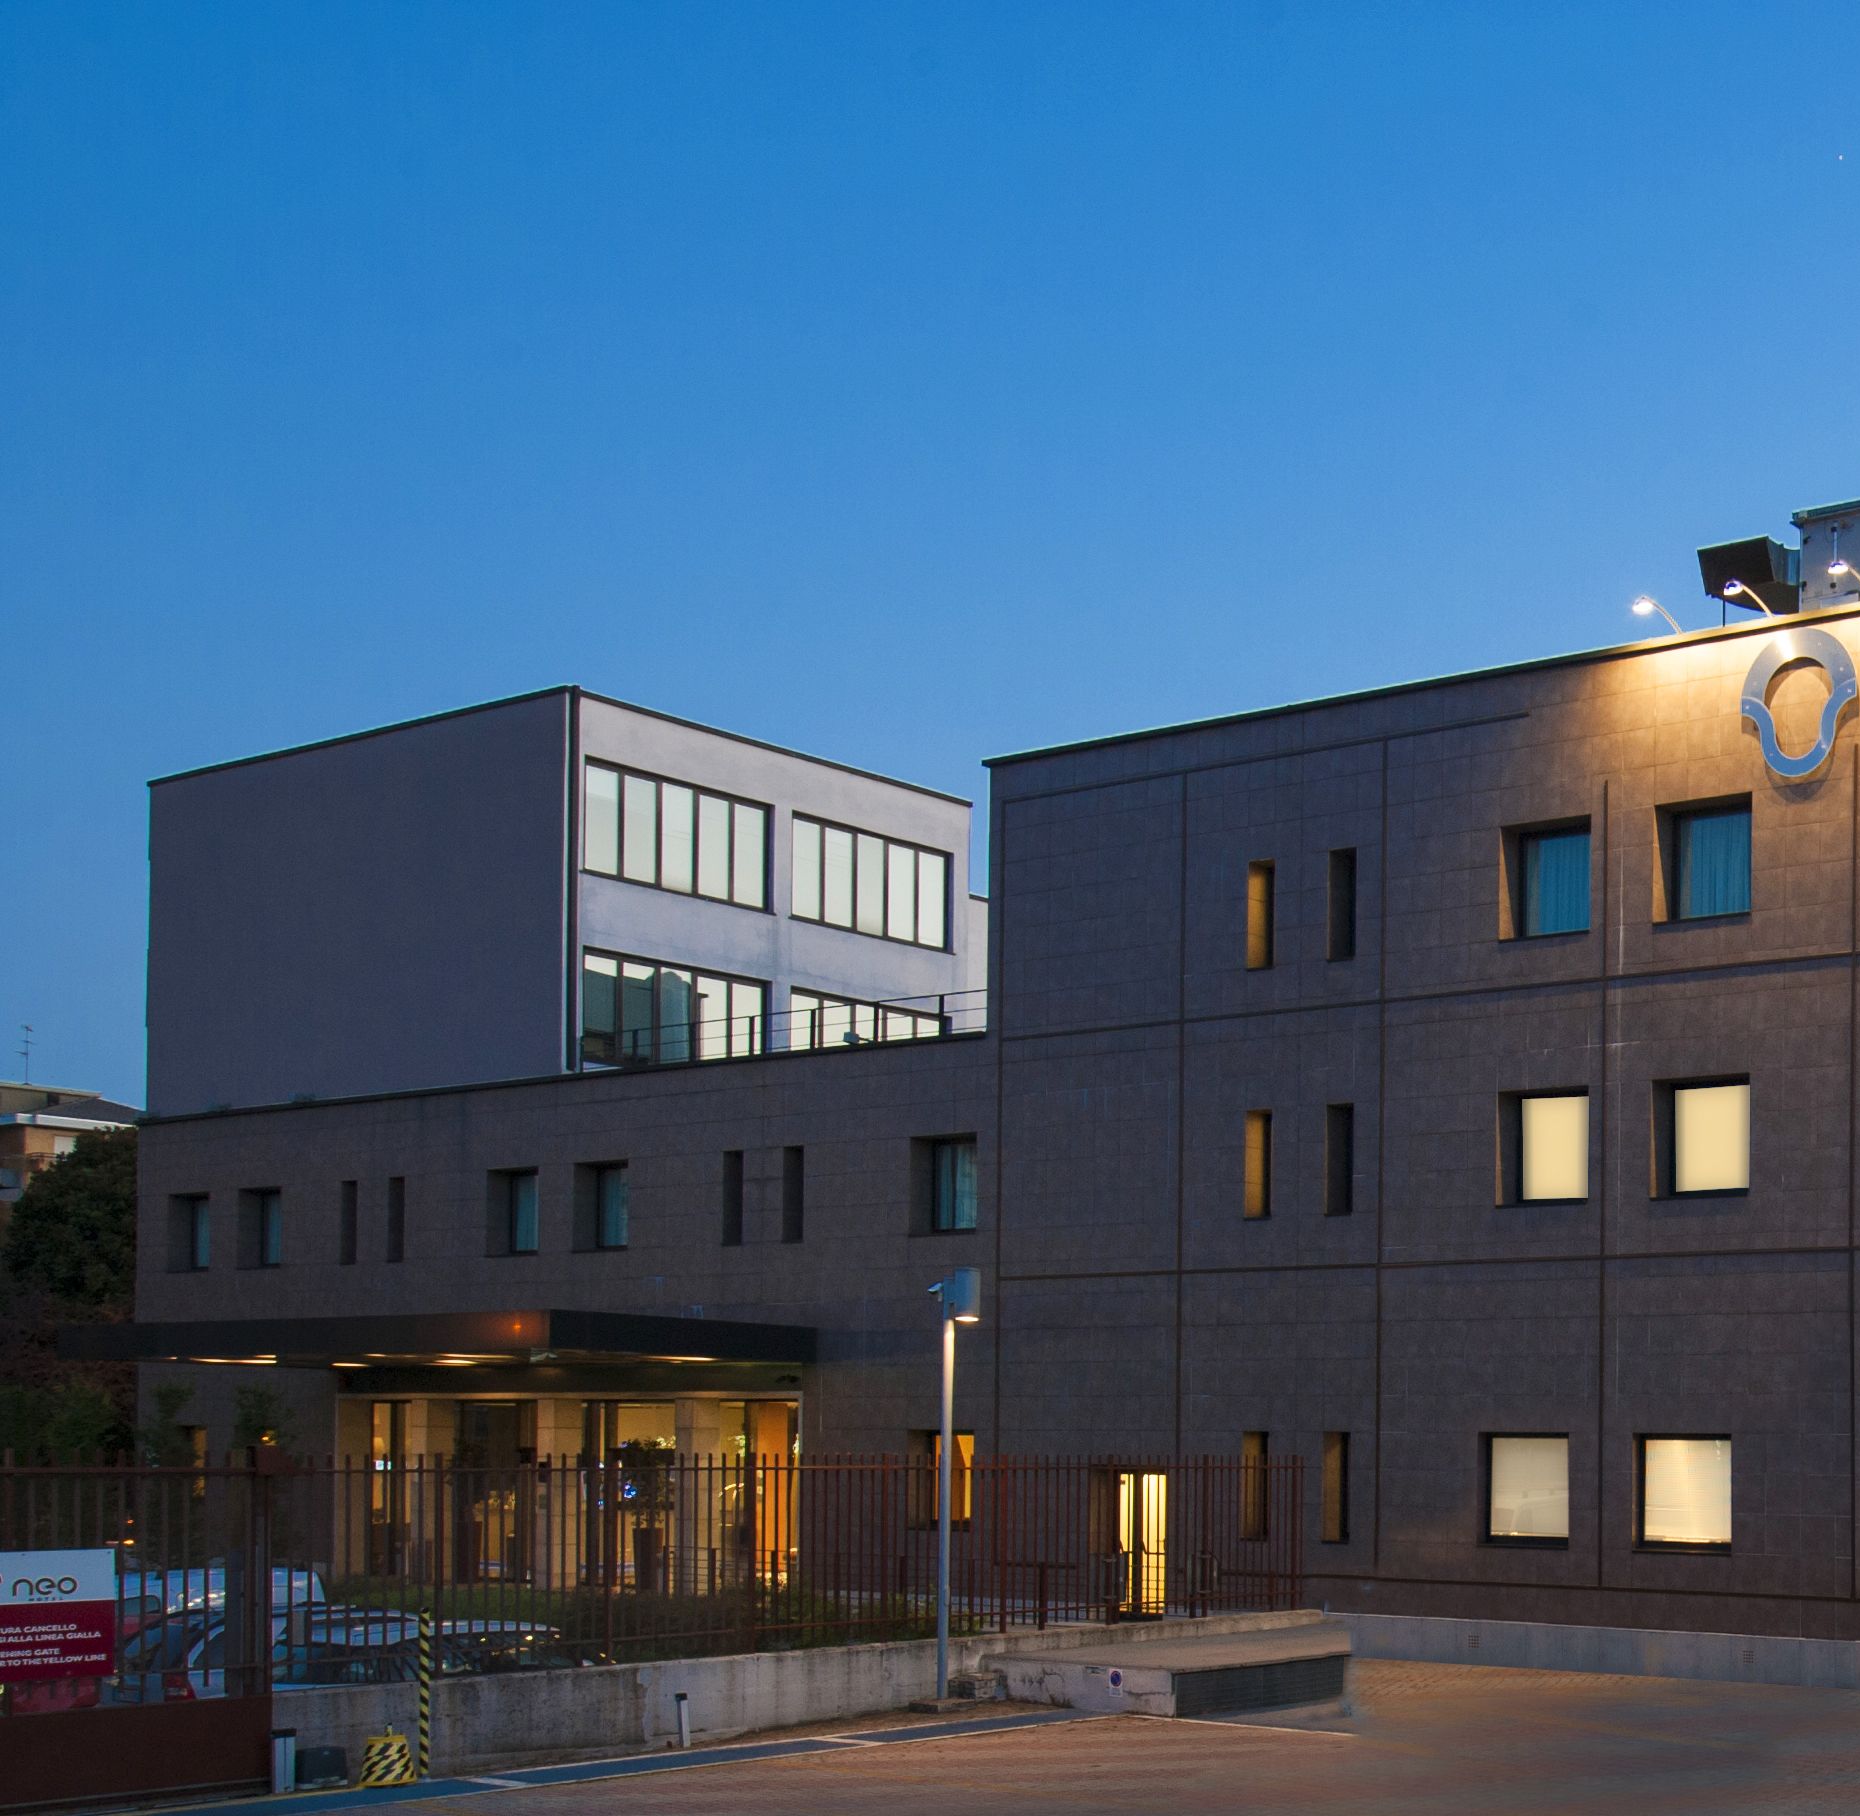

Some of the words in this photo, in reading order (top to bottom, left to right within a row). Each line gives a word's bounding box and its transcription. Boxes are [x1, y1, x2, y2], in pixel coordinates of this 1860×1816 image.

[12, 1577, 78, 1597] neo
[0, 1626, 21, 1634] URA
[24, 1624, 77, 1633] CANCELLO
[8, 1635, 33, 1643] ALLA
[35, 1633, 65, 1641] LINEA
[66, 1631, 101, 1640] GIALLA
[0, 1650, 32, 1658] ENING
[34, 1648, 61, 1656] GATE
[7, 1659, 21, 1667] TO
[42, 1655, 83, 1664] YELLOW
[84, 1653, 107, 1662] LINE
